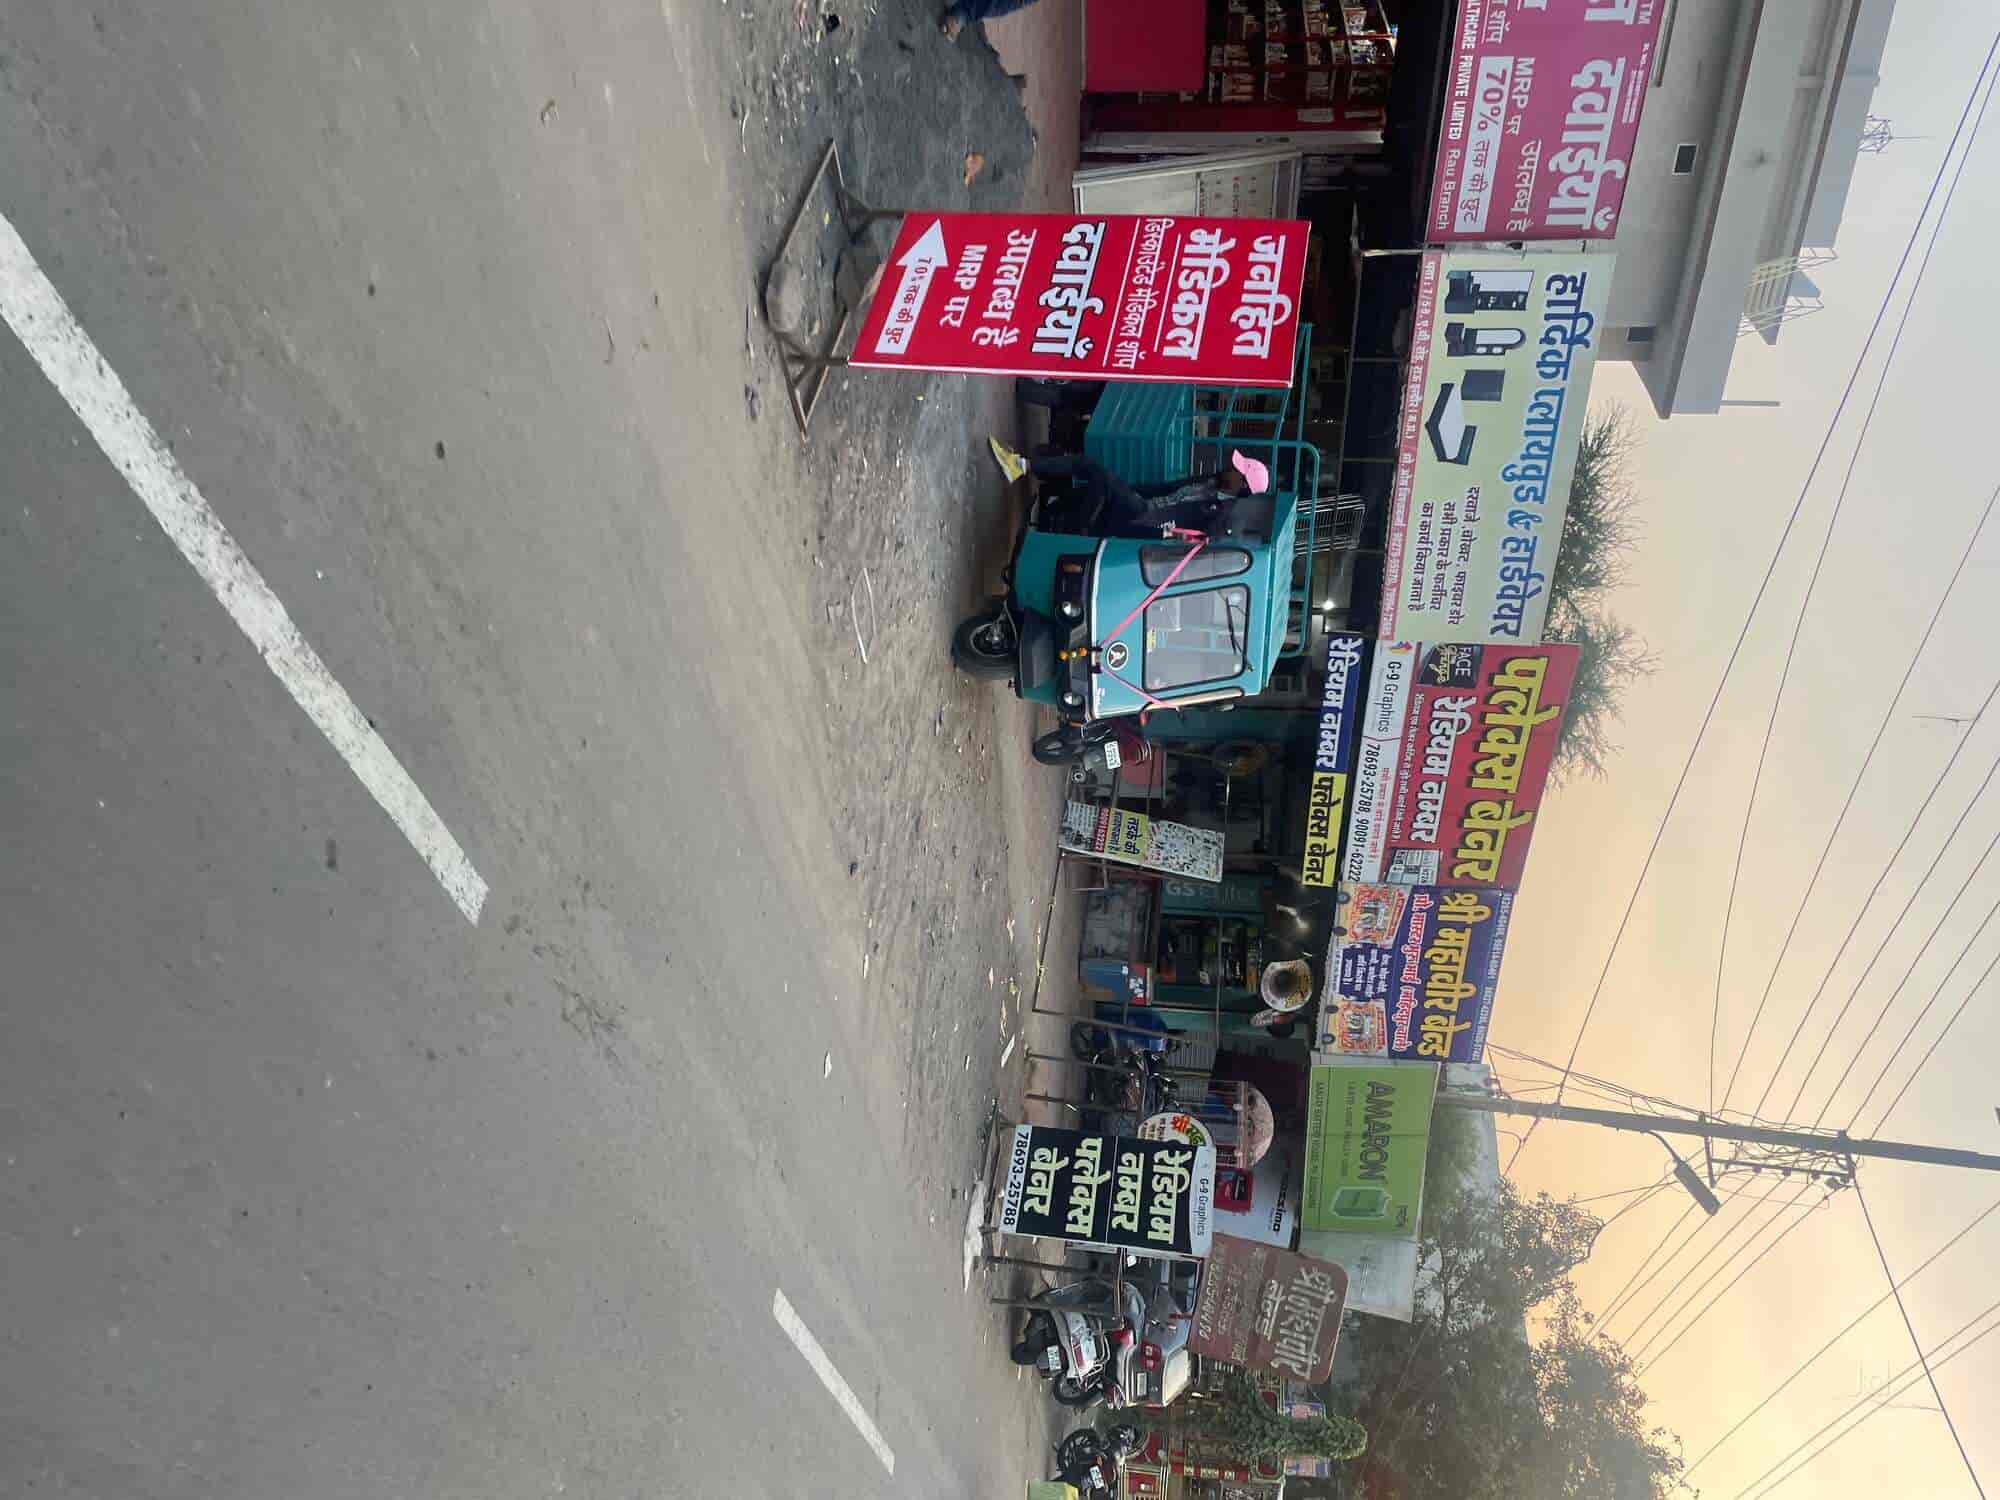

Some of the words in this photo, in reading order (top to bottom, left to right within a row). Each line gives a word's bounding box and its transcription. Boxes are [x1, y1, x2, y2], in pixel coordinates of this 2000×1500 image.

[1455, 55, 1474, 97] PRIVATE
[1476, 68, 1508, 131] 70%
[1512, 57, 1535, 109] MRP
[1448, 101, 1468, 140] LIMITED
[1505, 114, 1522, 136] पर
[1445, 148, 1461, 177] Rau
[1472, 139, 1491, 168] तक
[1510, 139, 1541, 214] उपलब्ध
[1437, 181, 1457, 230] Branch
[1467, 172, 1489, 192] की
[1506, 217, 1534, 233] है
[952, 244, 987, 290] MRP
[981, 229, 1038, 321] उपलब्ध
[1031, 221, 1106, 360] दवाईयाँ
[896, 308, 914, 324] की
[903, 284, 920, 304] तक
[939, 296, 970, 328] पर
[1118, 288, 1159, 338] मेडिकल
[1162, 228, 1236, 361] मेडिकल
[1229, 235, 1291, 359] जनहित
[971, 326, 1020, 347] है
[1535, 272, 1594, 381] हार्दिक
[1111, 340, 1146, 369] शॉप
[1501, 388, 1566, 504] प्लायवुड
[1507, 510, 1543, 530] &
[1490, 536, 1545, 637] हार्डवेयर
[1319, 637, 1363, 707] रेडियम
[1386, 661, 1402, 681] G-9
[1455, 647, 1473, 676] FACE
[1374, 684, 1398, 734] Graphics
[1471, 656, 1560, 793] फ्लेक्स
[1315, 713, 1342, 768] नम्बर
[1421, 696, 1477, 776] रेडियम
[1308, 776, 1341, 839] फ्लेक्स
[1409, 781, 1447, 844] नम्बर
[1305, 842, 1335, 883] बेनर
[1347, 818, 1374, 882] 90091-62222
[1452, 800, 1533, 882] बेनर
[1437, 893, 1492, 924] श्री
[1423, 928, 1477, 1012] महावीर
[1358, 1081, 1395, 1181] AMARON
[1003, 1132, 1029, 1225] 78693-25788
[1023, 1147, 1069, 1216] बेनर
[1065, 1137, 1111, 1238] फ्लेक्स
[1111, 1152, 1144, 1232] नम्बर
[1147, 1149, 1193, 1244] रेडियम
[1199, 1178, 1209, 1193] G-9
[1193, 1195, 1208, 1236] Graphics
